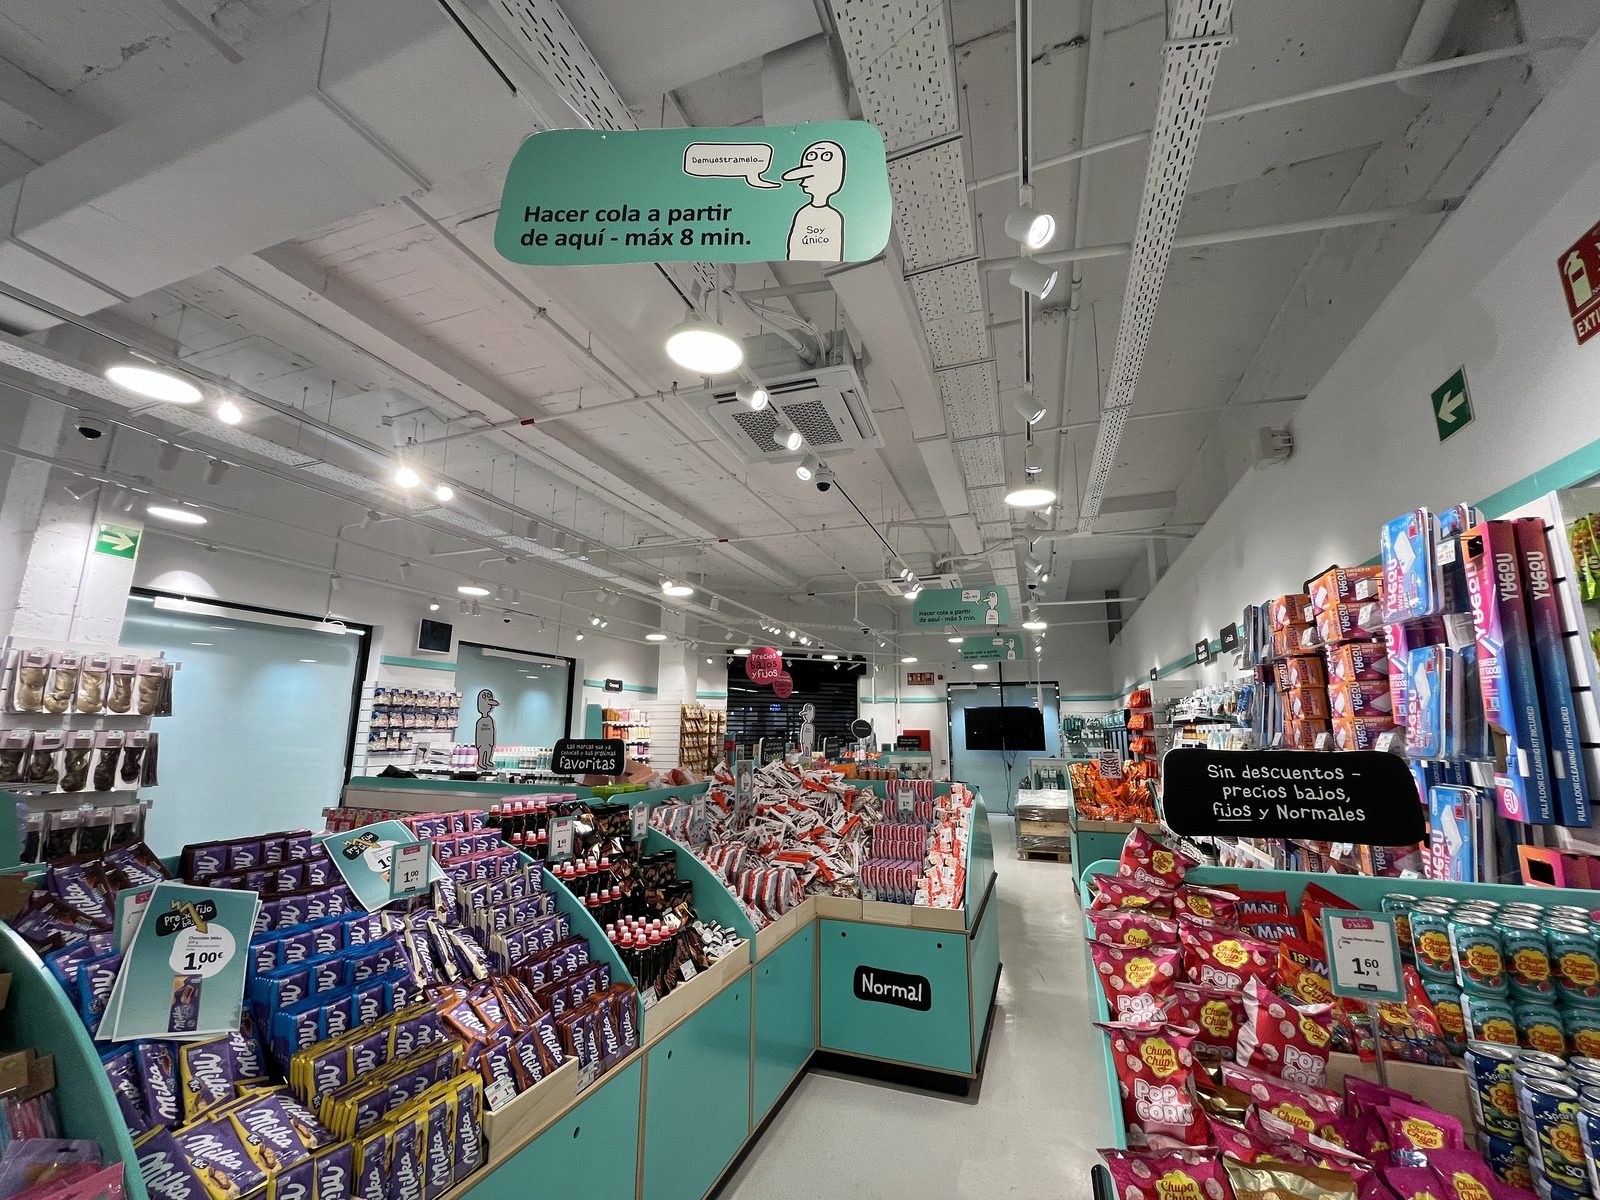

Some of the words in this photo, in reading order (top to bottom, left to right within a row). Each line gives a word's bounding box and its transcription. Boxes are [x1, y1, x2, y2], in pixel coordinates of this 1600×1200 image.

[523, 205, 589, 223] Hacer
[595, 204, 641, 223] cola
[647, 208, 660, 223] a
[667, 204, 733, 227] partir
[520, 228, 549, 247] de
[554, 226, 604, 251] aquí
[624, 228, 674, 247] máx
[680, 228, 694, 246] 8
[700, 227, 753, 246] min.
[802, 234, 830, 246] único
[806, 225, 826, 237] Soy
[956, 609, 971, 617] partir
[751, 660, 777, 669] bajos
[752, 653, 777, 661] precios
[1526, 706, 1538, 737] INCLUDED
[1561, 706, 1573, 739] INCLUDED
[1530, 738, 1539, 748] KIT
[1565, 738, 1574, 749] KIT
[560, 756, 616, 770] favoritas
[1207, 764, 1235, 778] Sin
[1241, 765, 1345, 780] descuentos
[1533, 749, 1544, 781] CLEANING
[1568, 750, 1579, 782] CLEANING
[1223, 784, 1287, 800] precios
[1296, 784, 1351, 803] bajos,
[1538, 780, 1547, 803] FLOOR
[1573, 782, 1582, 804] FLOOR
[1213, 801, 1252, 818] fijos
[1259, 807, 1269, 820] y
[1276, 804, 1366, 821] Normales
[1541, 803, 1549, 819] FULL
[1577, 805, 1586, 822] FULL
[440, 878, 458, 909] Milka
[196, 904, 213, 914] fijo
[416, 936, 433, 973] Milka
[1217, 944, 1243, 957] Chupa
[1472, 951, 1498, 961] Chupa
[1129, 964, 1153, 972] Chupa
[1471, 958, 1499, 972] Chups
[1518, 962, 1545, 977] Chups
[1519, 956, 1546, 965] Chupa
[1564, 959, 1595, 970] Chupa
[1201, 965, 1242, 989] POP
[1564, 967, 1595, 981] Chups
[862, 972, 922, 1002] Normal
[1117, 993, 1154, 1012] POP
[1205, 1007, 1230, 1017] Chupa
[623, 1010, 635, 1047] Milka
[1204, 1016, 1229, 1032] Chups
[540, 1024, 563, 1064] Milka
[603, 1016, 619, 1055] Milka
[229, 1032, 260, 1077] Milka
[1145, 1046, 1172, 1058] Chupa
[1284, 1045, 1326, 1074] POP
[1145, 1055, 1175, 1072] Chups
[148, 1063, 179, 1120] Milka
[1134, 1078, 1177, 1103] POP
[277, 1096, 318, 1127] Milka
[1136, 1097, 1194, 1126] CORN
[1277, 1109, 1310, 1128] Chupa
[245, 1109, 293, 1149] Milka
[460, 1111, 479, 1164] Milka
[1407, 1122, 1437, 1138] Chupa
[1407, 1130, 1438, 1148] Chups
[185, 1134, 243, 1171] Milka
[430, 1130, 449, 1186] Milka
[1161, 1179, 1194, 1194] Chupa
[1456, 1179, 1485, 1192] Chupa
